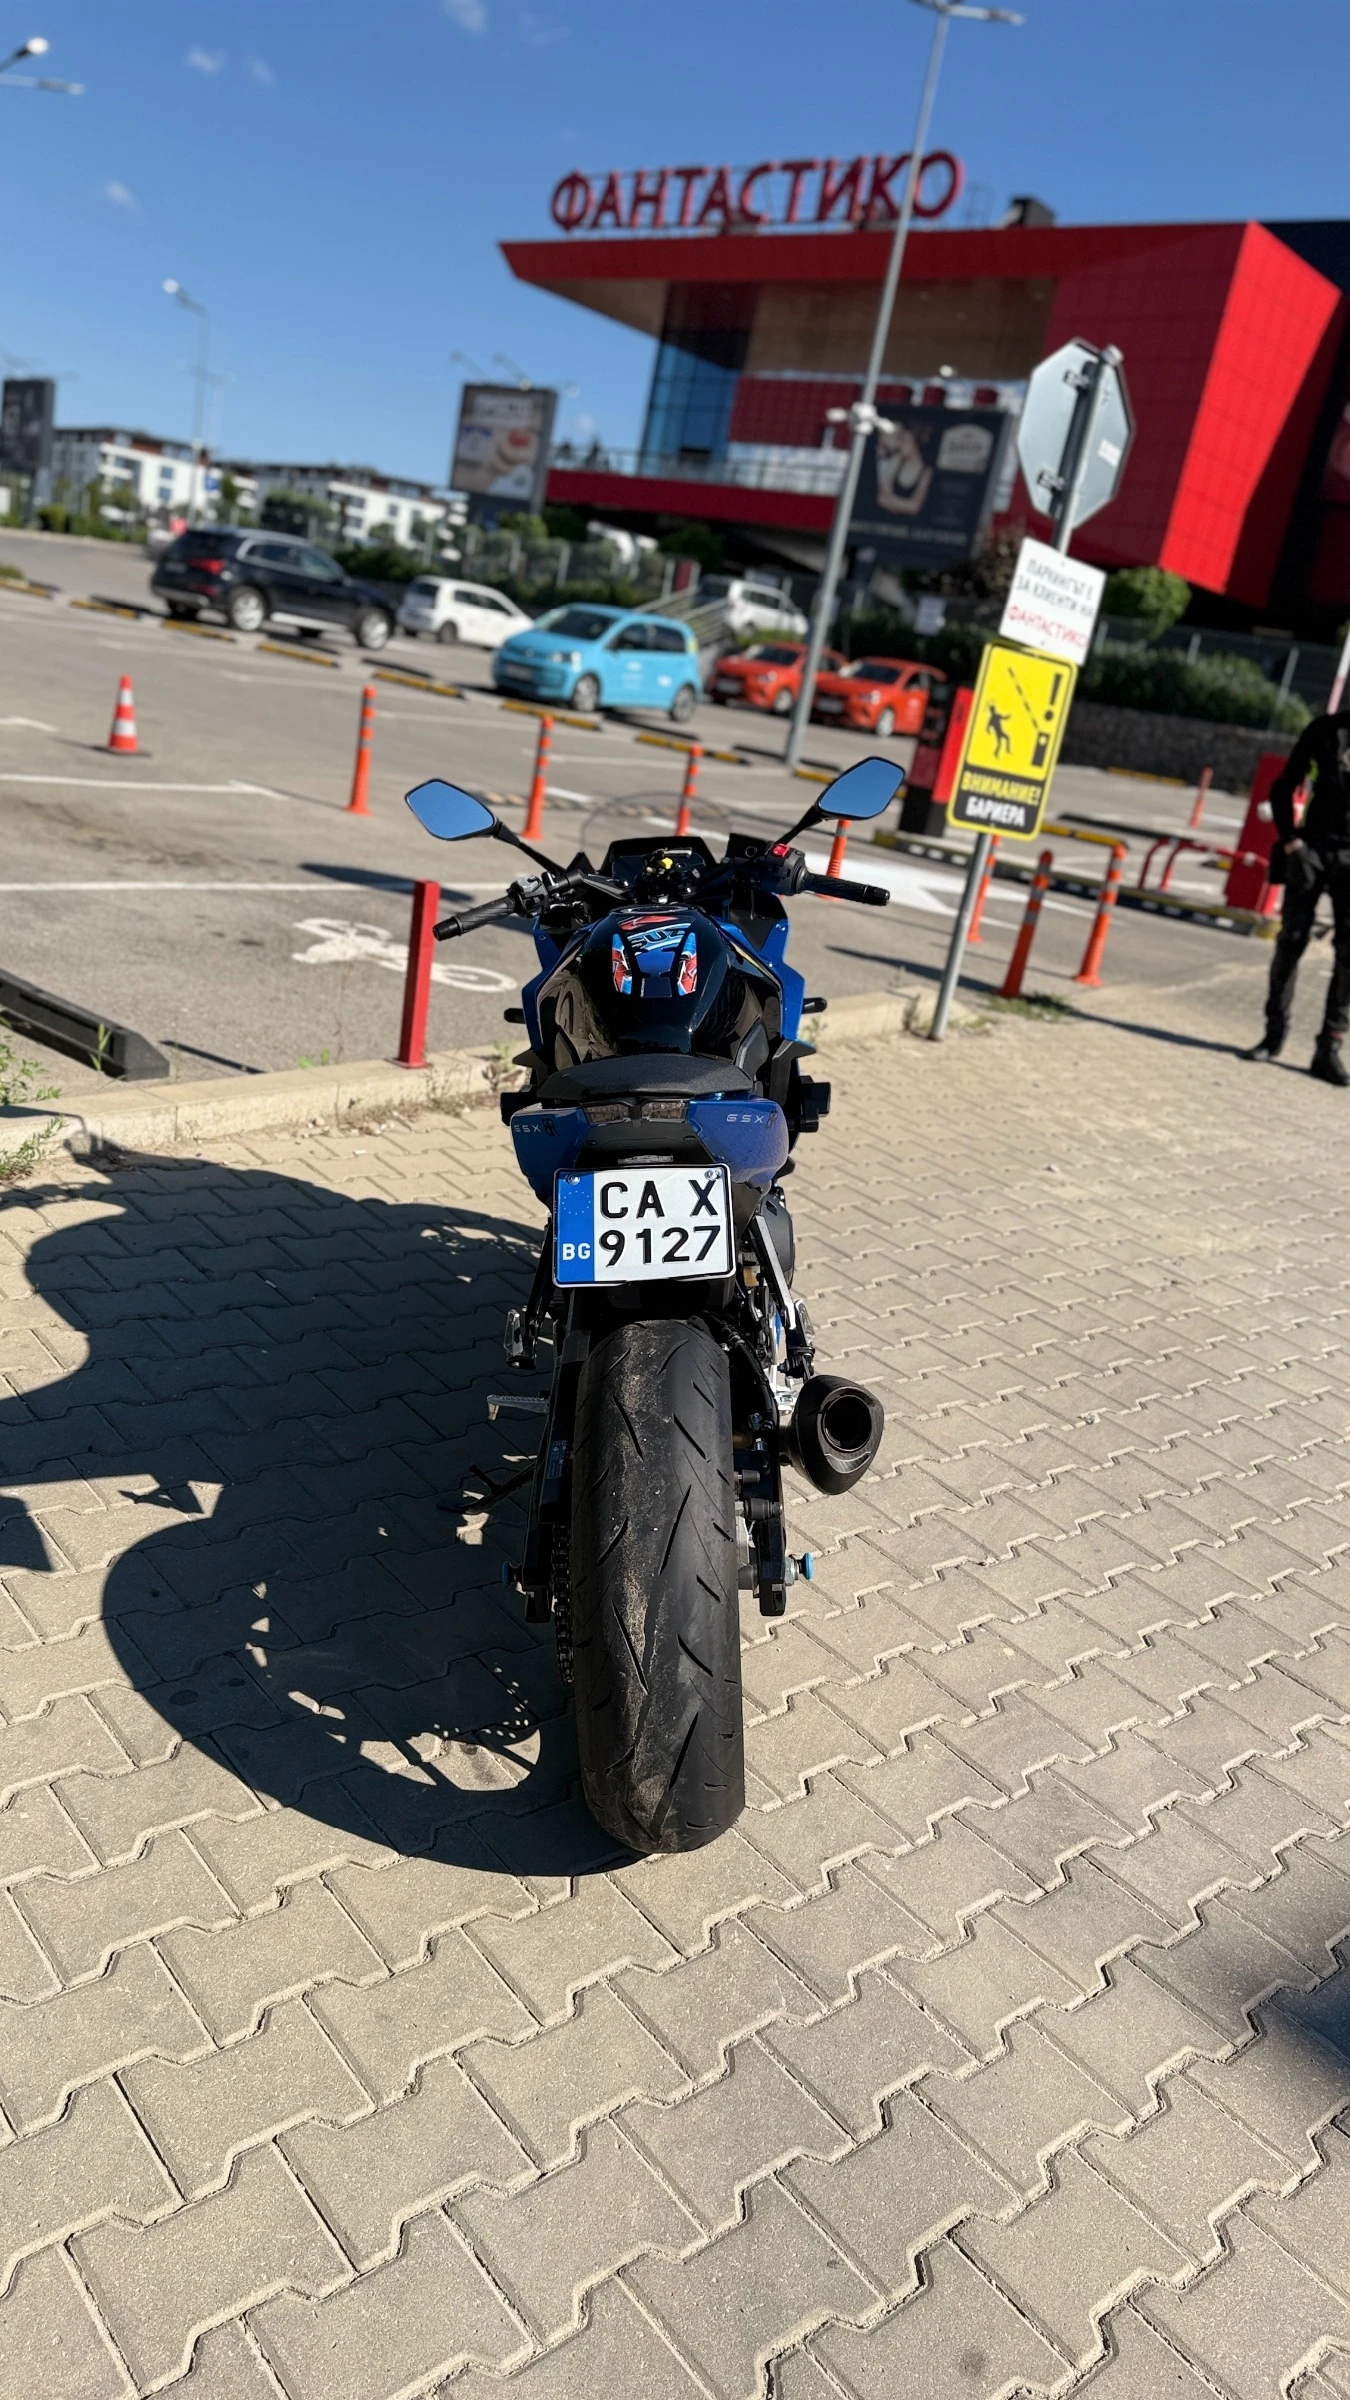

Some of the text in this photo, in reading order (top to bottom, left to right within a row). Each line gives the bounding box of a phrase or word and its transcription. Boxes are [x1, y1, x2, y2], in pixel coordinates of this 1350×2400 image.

[551, 150, 965, 231] ФАНТАСТИКО
[1016, 575, 1031, 592] ЗА
[1032, 582, 1078, 611] КЛИЕНТИ
[1007, 604, 1089, 648] ФАНТАСТИКО
[961, 770, 1043, 807] ВНИМАНИЕ!
[965, 795, 1026, 828] БАРИЕРА
[513, 1124, 542, 1133] GSX
[726, 1113, 765, 1124] GSX
[600, 1179, 719, 1219] CA X
[562, 1242, 591, 1261] BG
[598, 1225, 722, 1268] 9127
